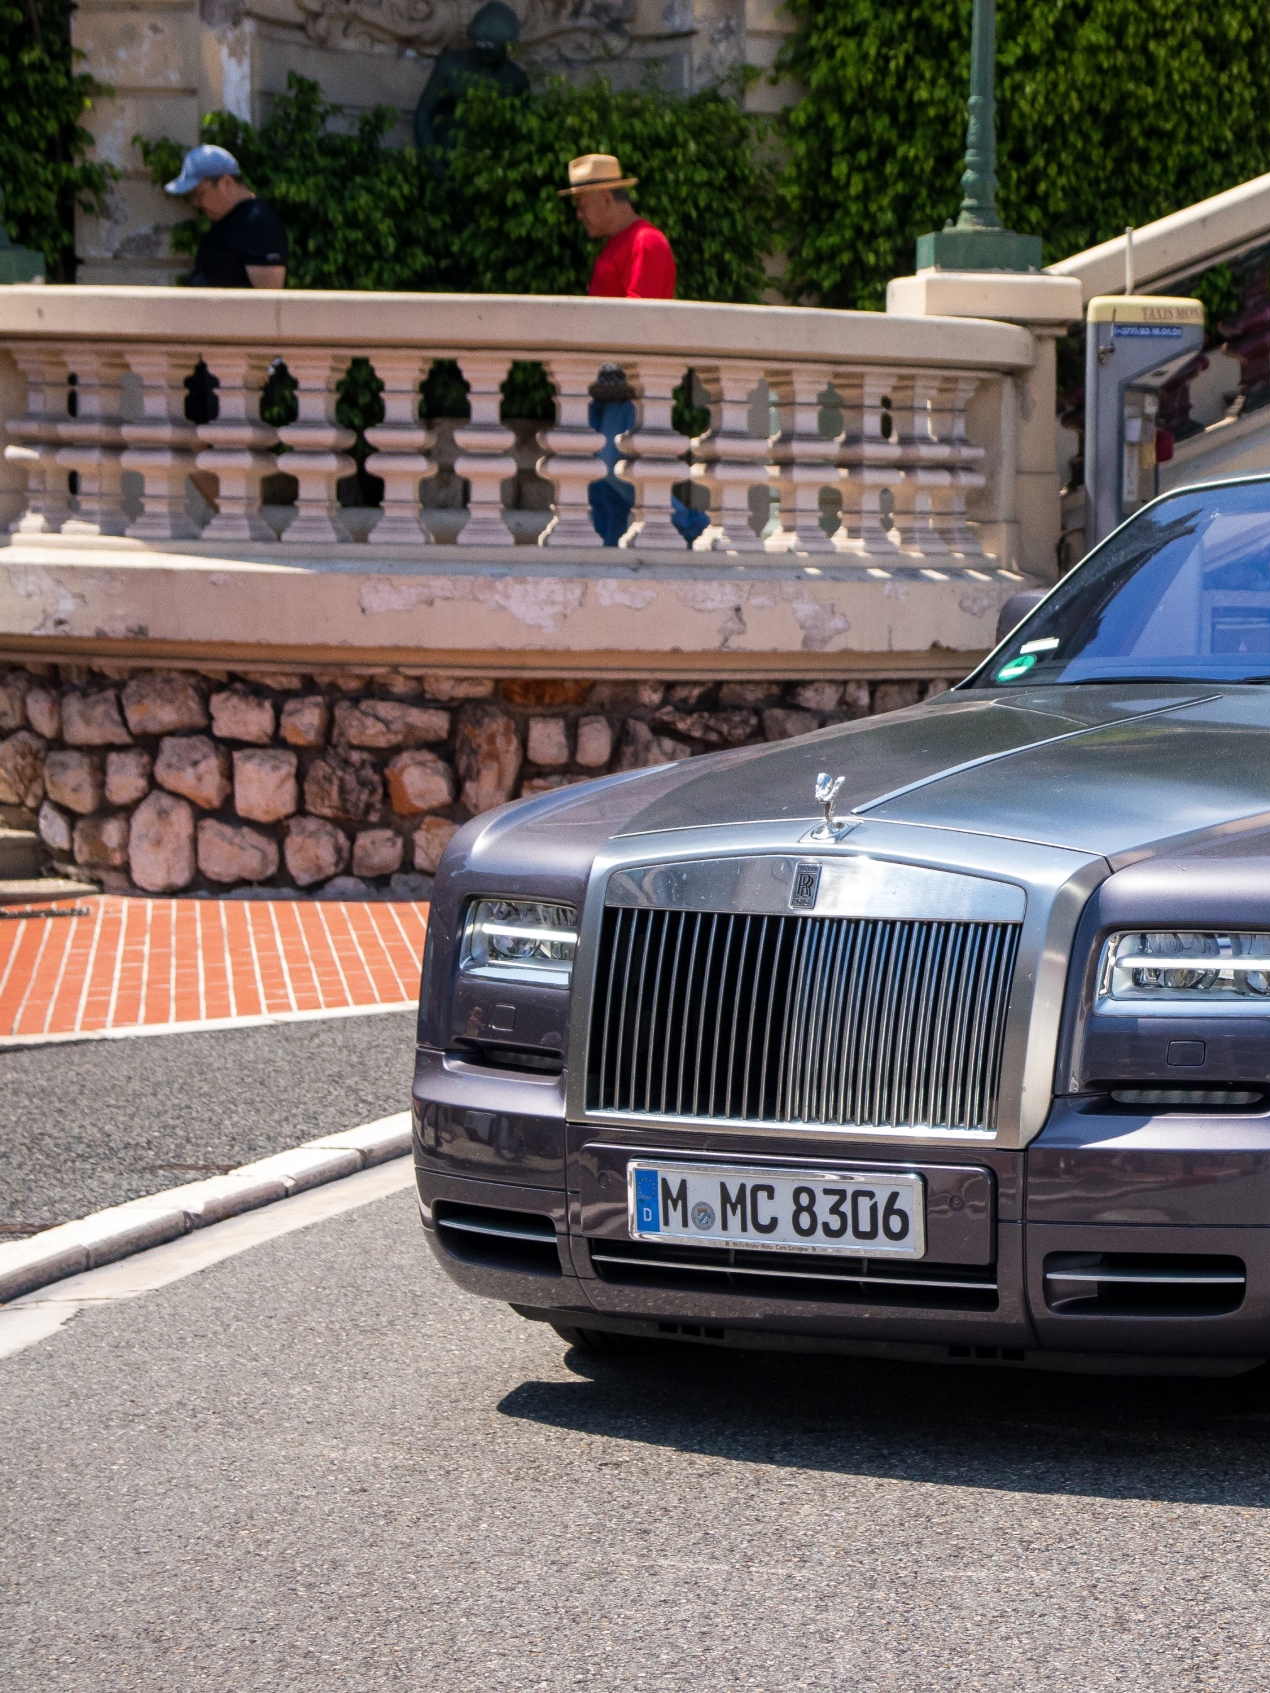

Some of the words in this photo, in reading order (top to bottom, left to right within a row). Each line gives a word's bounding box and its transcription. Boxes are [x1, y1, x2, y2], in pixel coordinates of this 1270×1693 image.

[1141, 306, 1173, 320] TAXIS
[643, 1208, 652, 1221] D
[661, 1177, 689, 1228] M
[720, 1181, 779, 1234] MC
[792, 1185, 910, 1241] 8306
